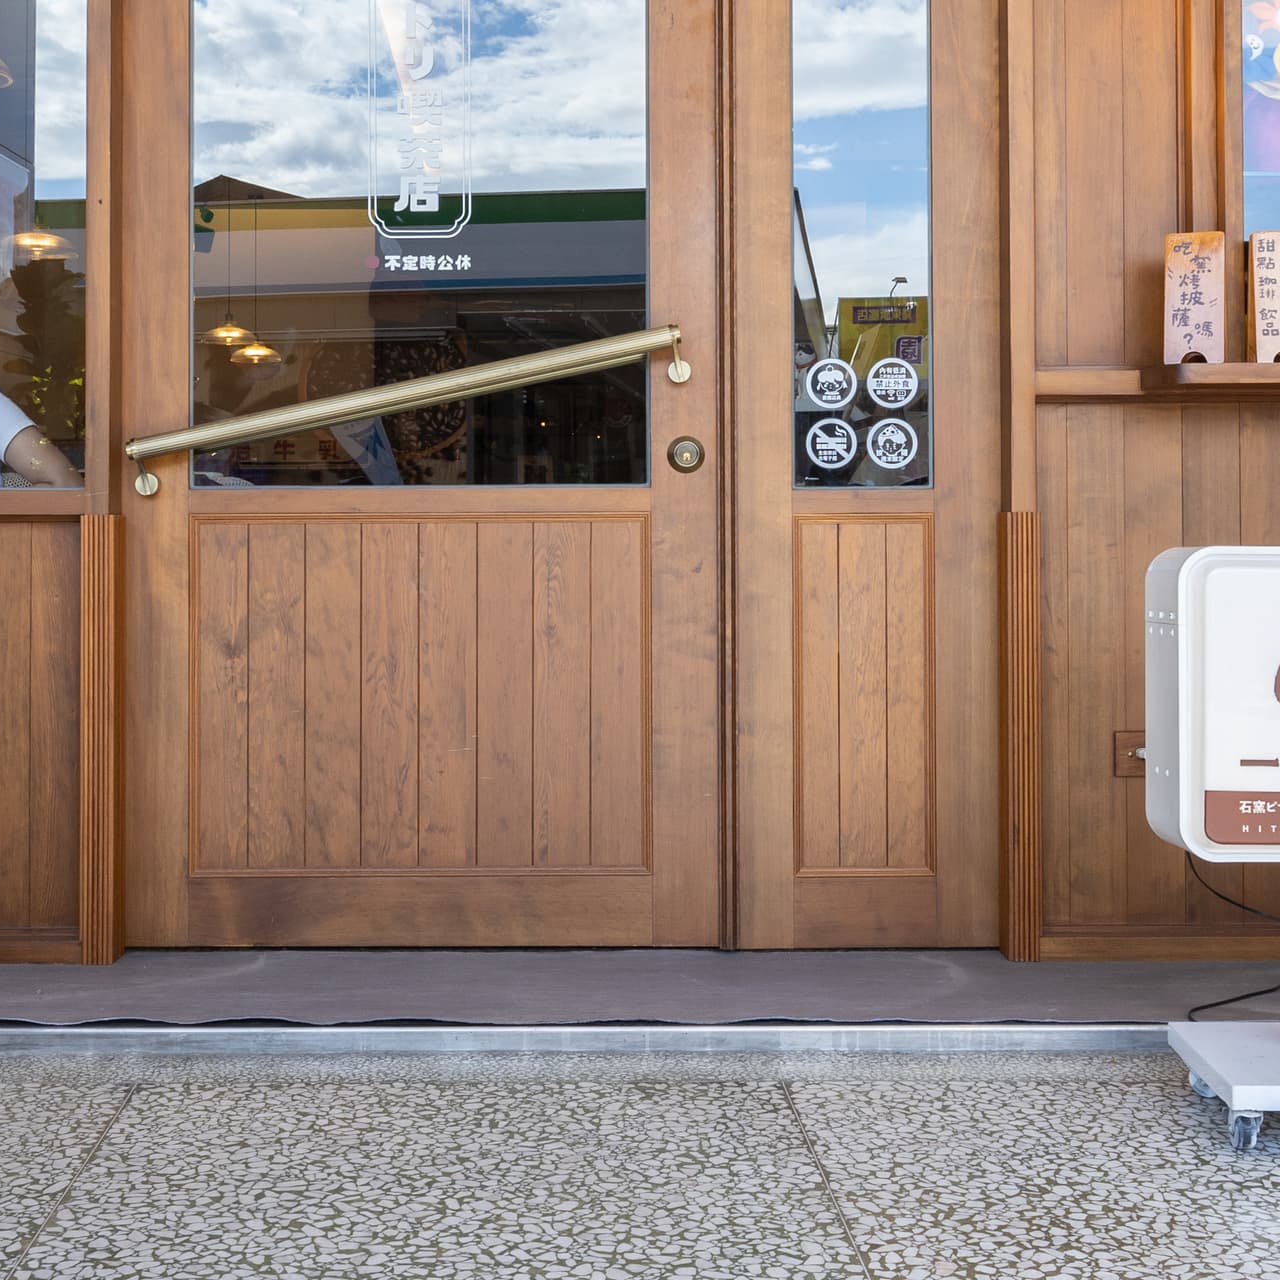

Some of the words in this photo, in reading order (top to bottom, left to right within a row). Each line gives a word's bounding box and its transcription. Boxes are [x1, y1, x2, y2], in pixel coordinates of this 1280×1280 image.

[384, 254, 472, 271] 不定時公休
